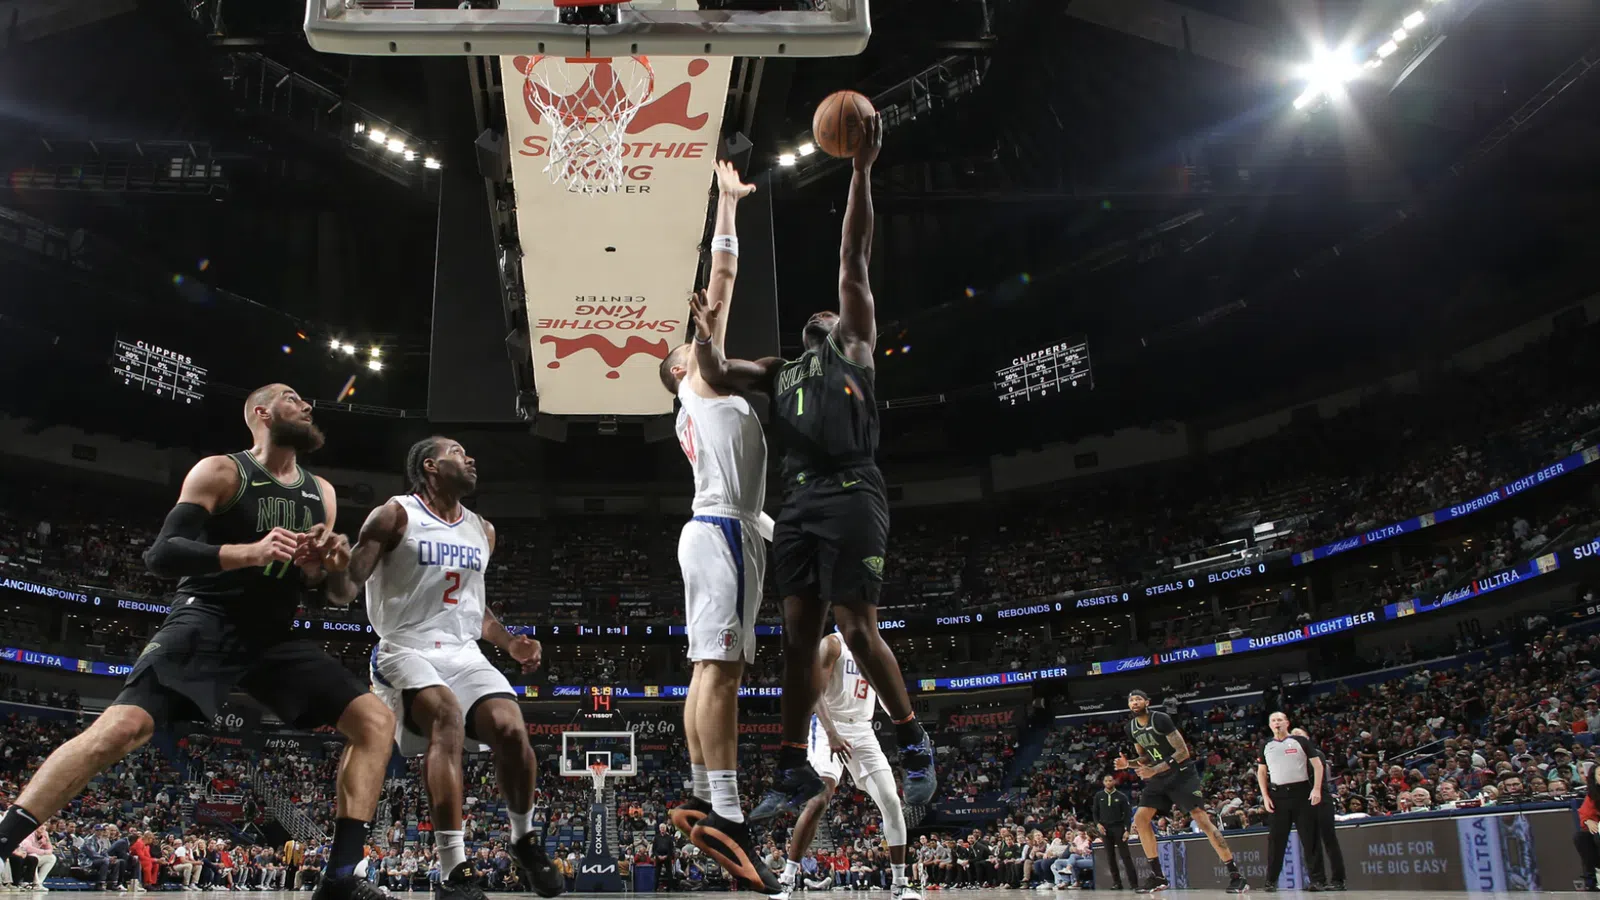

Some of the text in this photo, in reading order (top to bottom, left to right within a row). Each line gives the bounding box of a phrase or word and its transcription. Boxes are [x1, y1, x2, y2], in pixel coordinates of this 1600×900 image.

[575, 295, 646, 303] CENTER
[535, 318, 681, 333] SMOOTHIE
[136, 340, 192, 364] CLIPPERS
[1012, 342, 1067, 366] CLIPPERS
[795, 387, 804, 416] 1
[1450, 463, 1564, 517] SUPERIOR LIGHT BEER
[256, 496, 313, 532] NOLA
[1367, 524, 1403, 542] ULTRA
[418, 540, 481, 572] CLIPPERS
[442, 571, 460, 605] 2
[1479, 569, 1520, 591] ULTRA
[936, 563, 1266, 625] POINTS 0 REBOUNDS 0 ASSISTS 0 STEALS 0 BLOCKS 0
[94, 597, 100, 606] 0
[117, 600, 172, 615] REBOUNDS
[323, 622, 361, 632] BLOCKS
[553, 626, 559, 634] 2
[646, 626, 652, 634] 5
[877, 620, 906, 630] UBAC
[1248, 611, 1375, 649] SUPERIOR LIGHT BEER
[25, 652, 62, 667] ULTRA
[1160, 649, 1199, 663] ULTRA
[950, 667, 1068, 688] SUPERIOR LIGHT BEER
[737, 687, 783, 696] GHT BEER
[854, 679, 870, 699] 13
[594, 695, 610, 710] 14
[225, 713, 244, 728] Go
[625, 720, 675, 734] Let's Go
[738, 723, 783, 734] EATGEEK
[525, 723, 582, 735] EATGEEK
[1368, 841, 1435, 856] MADE FOR
[1472, 817, 1494, 892] ULTRA
[1243, 851, 1260, 863] FOR
[1360, 858, 1448, 874] THE BIG EASY
